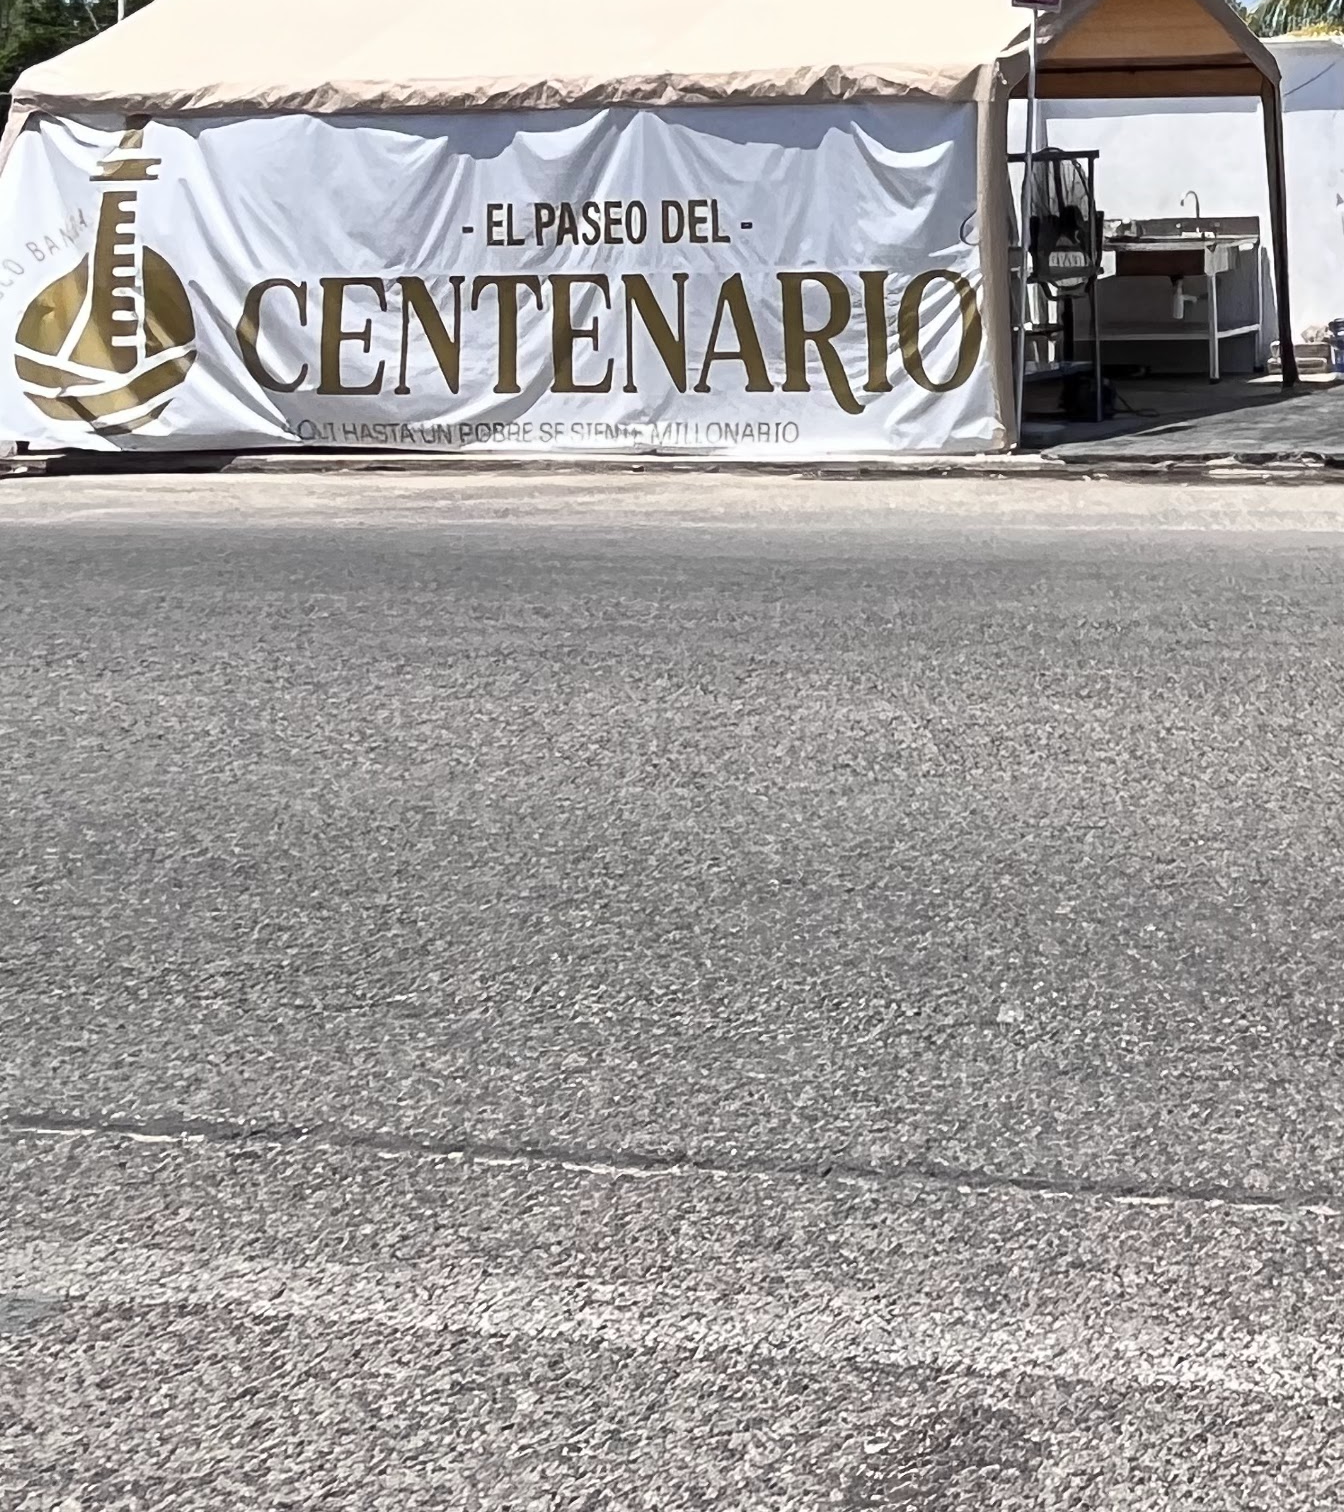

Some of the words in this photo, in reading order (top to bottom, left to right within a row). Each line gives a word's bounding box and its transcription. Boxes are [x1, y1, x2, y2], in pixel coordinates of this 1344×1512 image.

[487, 202, 524, 247] EL
[535, 201, 646, 247] PASEO
[661, 199, 731, 246] DEL
[235, 268, 982, 415] CENTENARIO
[341, 421, 415, 443] HASTA
[420, 422, 452, 444] UN
[458, 422, 534, 444] POBRE
[652, 420, 800, 444] MILLONARIO
